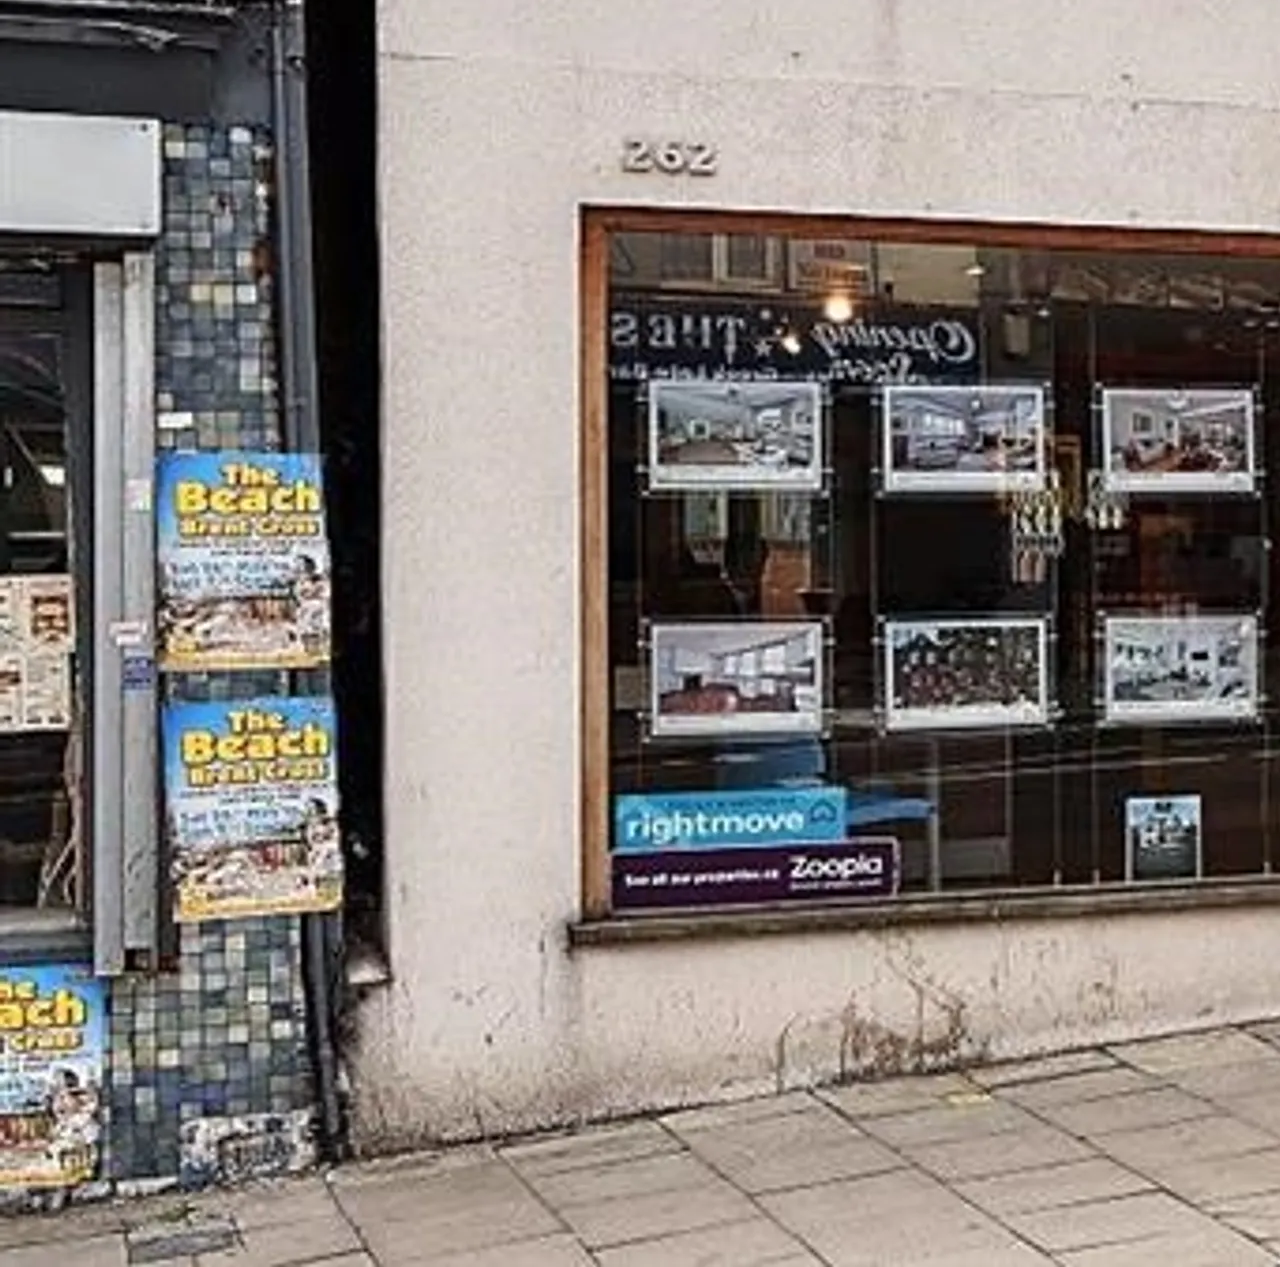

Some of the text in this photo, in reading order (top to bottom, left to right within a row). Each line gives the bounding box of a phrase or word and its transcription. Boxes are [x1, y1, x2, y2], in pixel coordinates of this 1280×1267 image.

[622, 139, 719, 177] 262
[221, 461, 281, 487] The
[174, 478, 323, 515] Beach
[228, 709, 285, 733] The
[181, 722, 331, 764] Beach
[625, 808, 805, 845] rightmove
[788, 853, 885, 881] Zoopla
[0, 988, 87, 1030] ach
